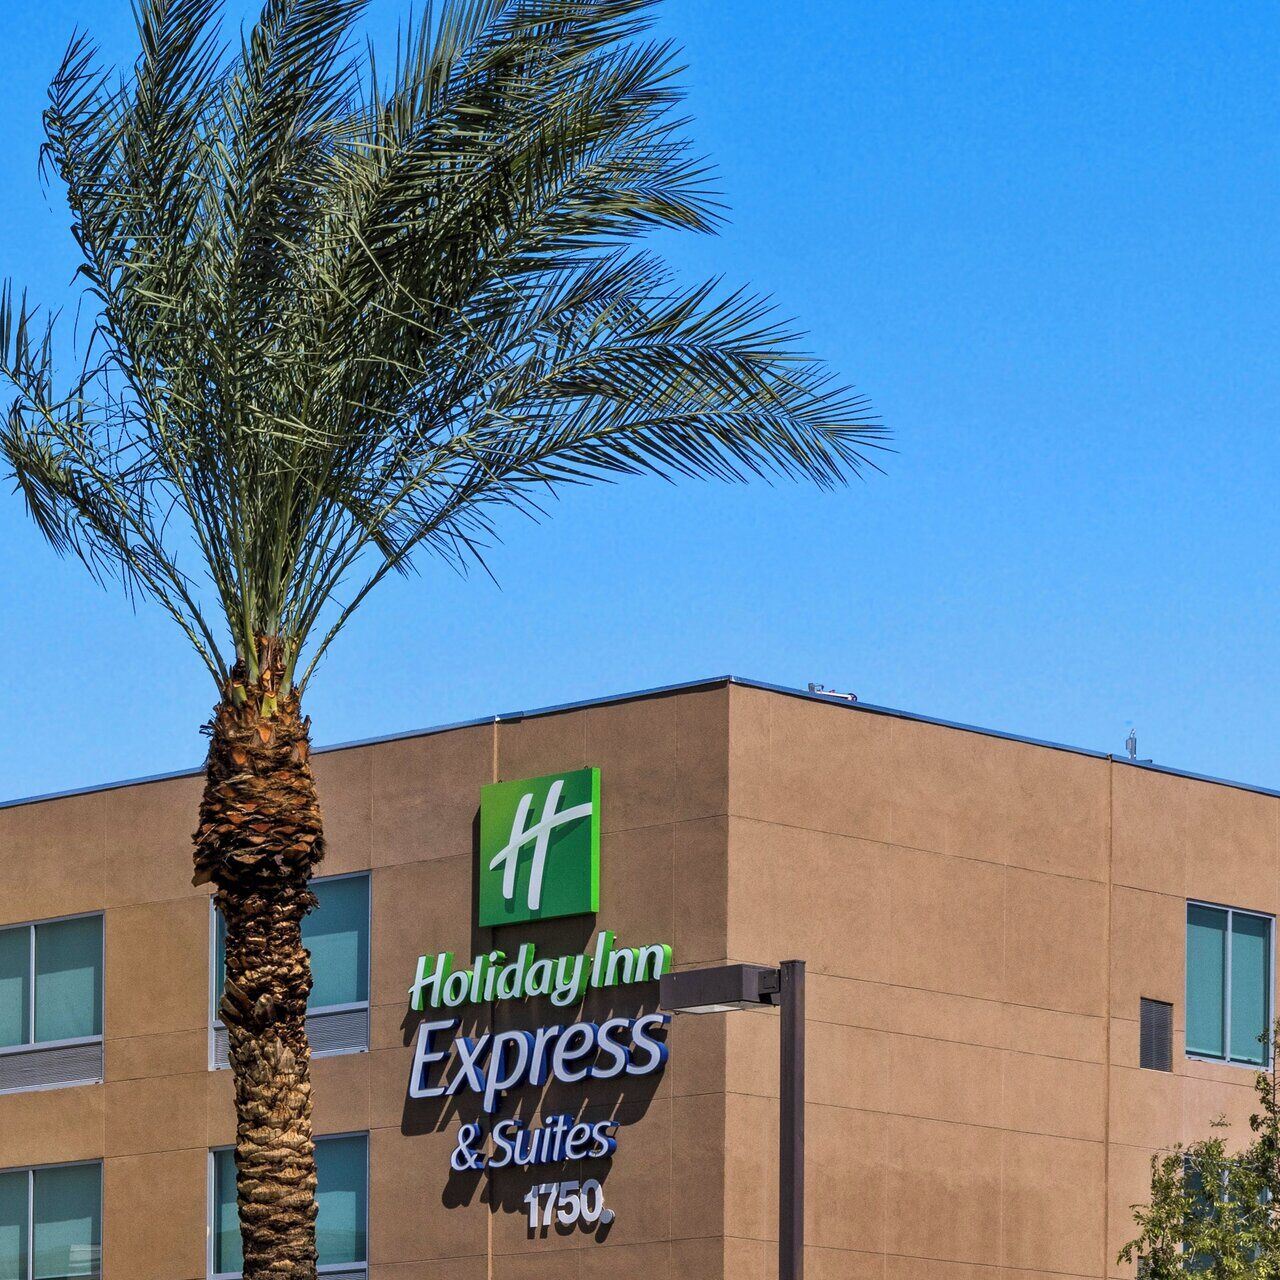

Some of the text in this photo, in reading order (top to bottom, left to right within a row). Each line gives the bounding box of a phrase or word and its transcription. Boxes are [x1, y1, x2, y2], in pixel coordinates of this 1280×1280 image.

[408, 930, 672, 1011] Holiday Inn
[409, 1013, 672, 1113] Express
[450, 1114, 620, 1171] & Suites
[524, 1179, 604, 1228] 1750
